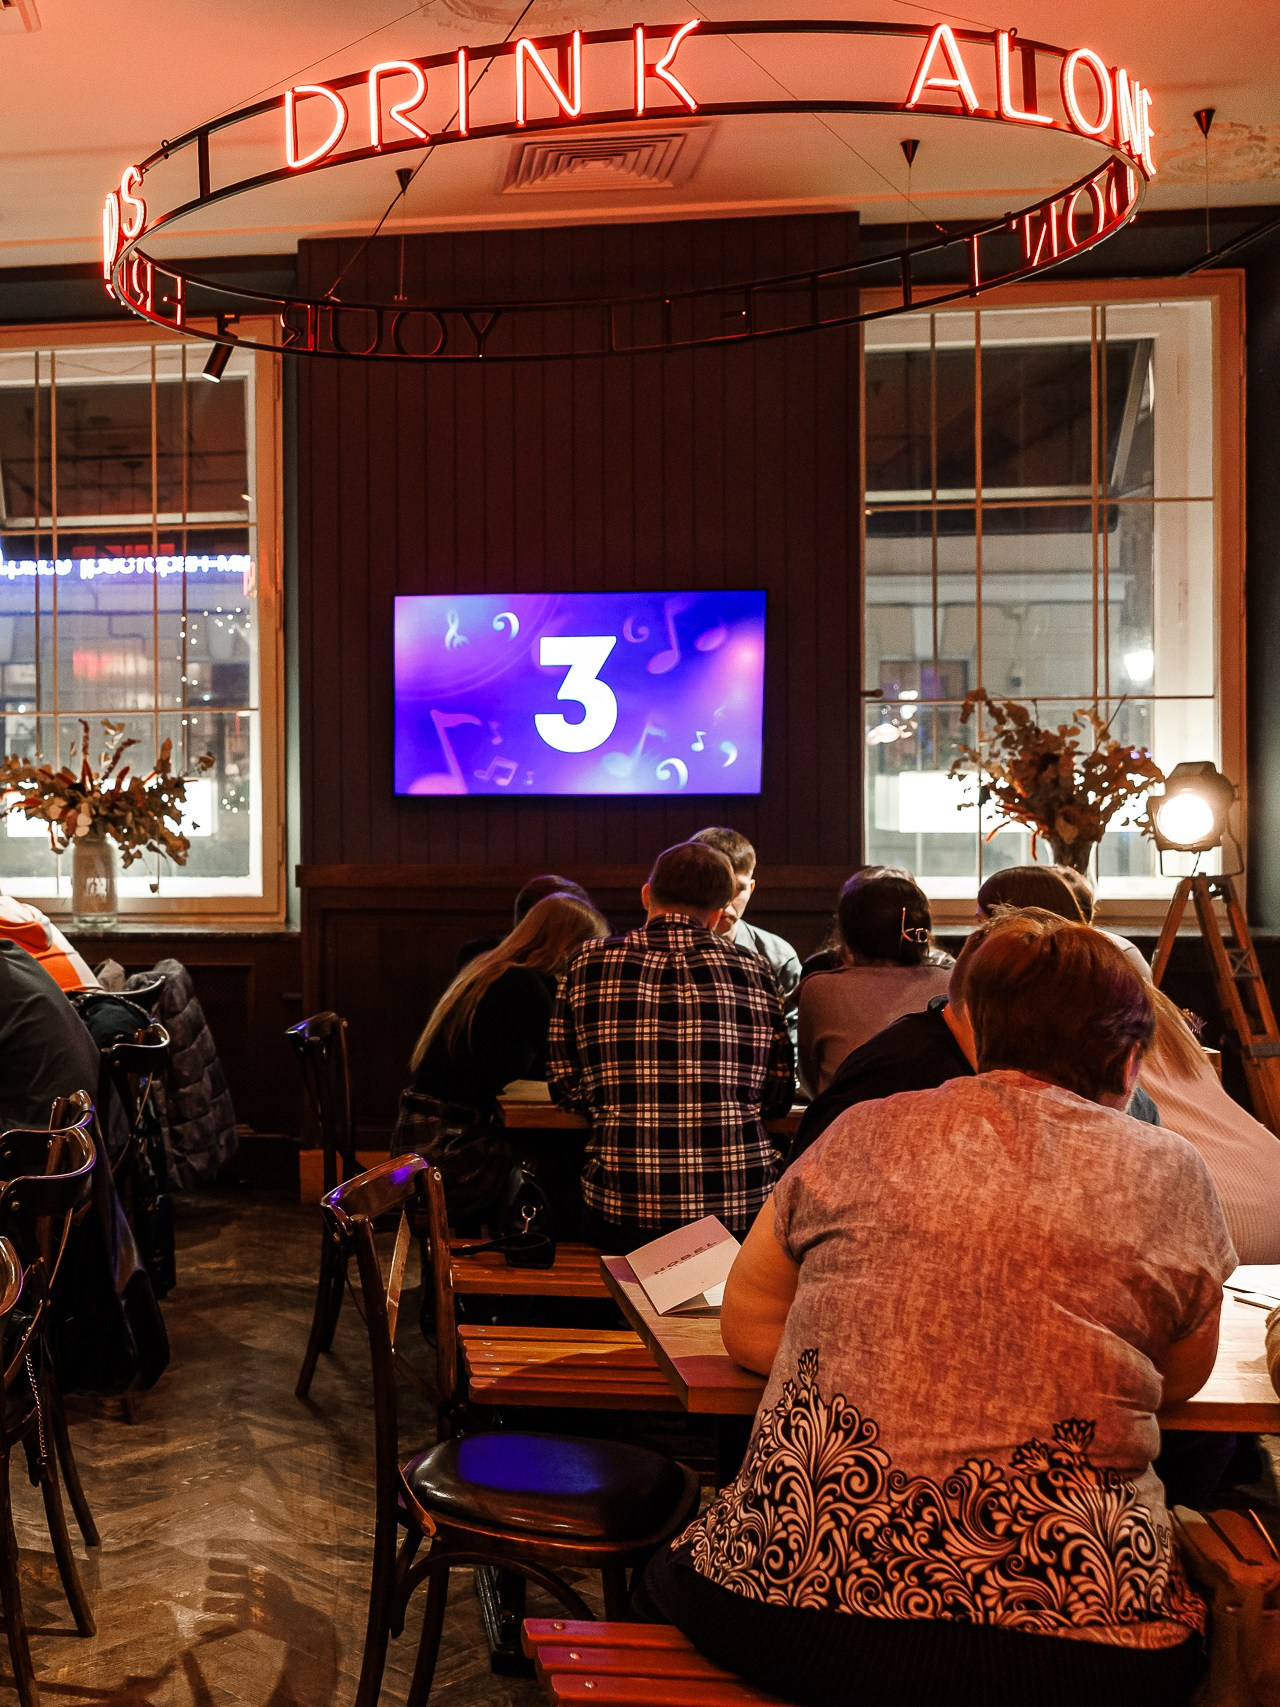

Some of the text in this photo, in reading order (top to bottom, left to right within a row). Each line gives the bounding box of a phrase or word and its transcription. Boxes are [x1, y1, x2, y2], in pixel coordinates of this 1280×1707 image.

[284, 18, 1157, 176] DRINK ALONE
[534, 636, 618, 753] 3
